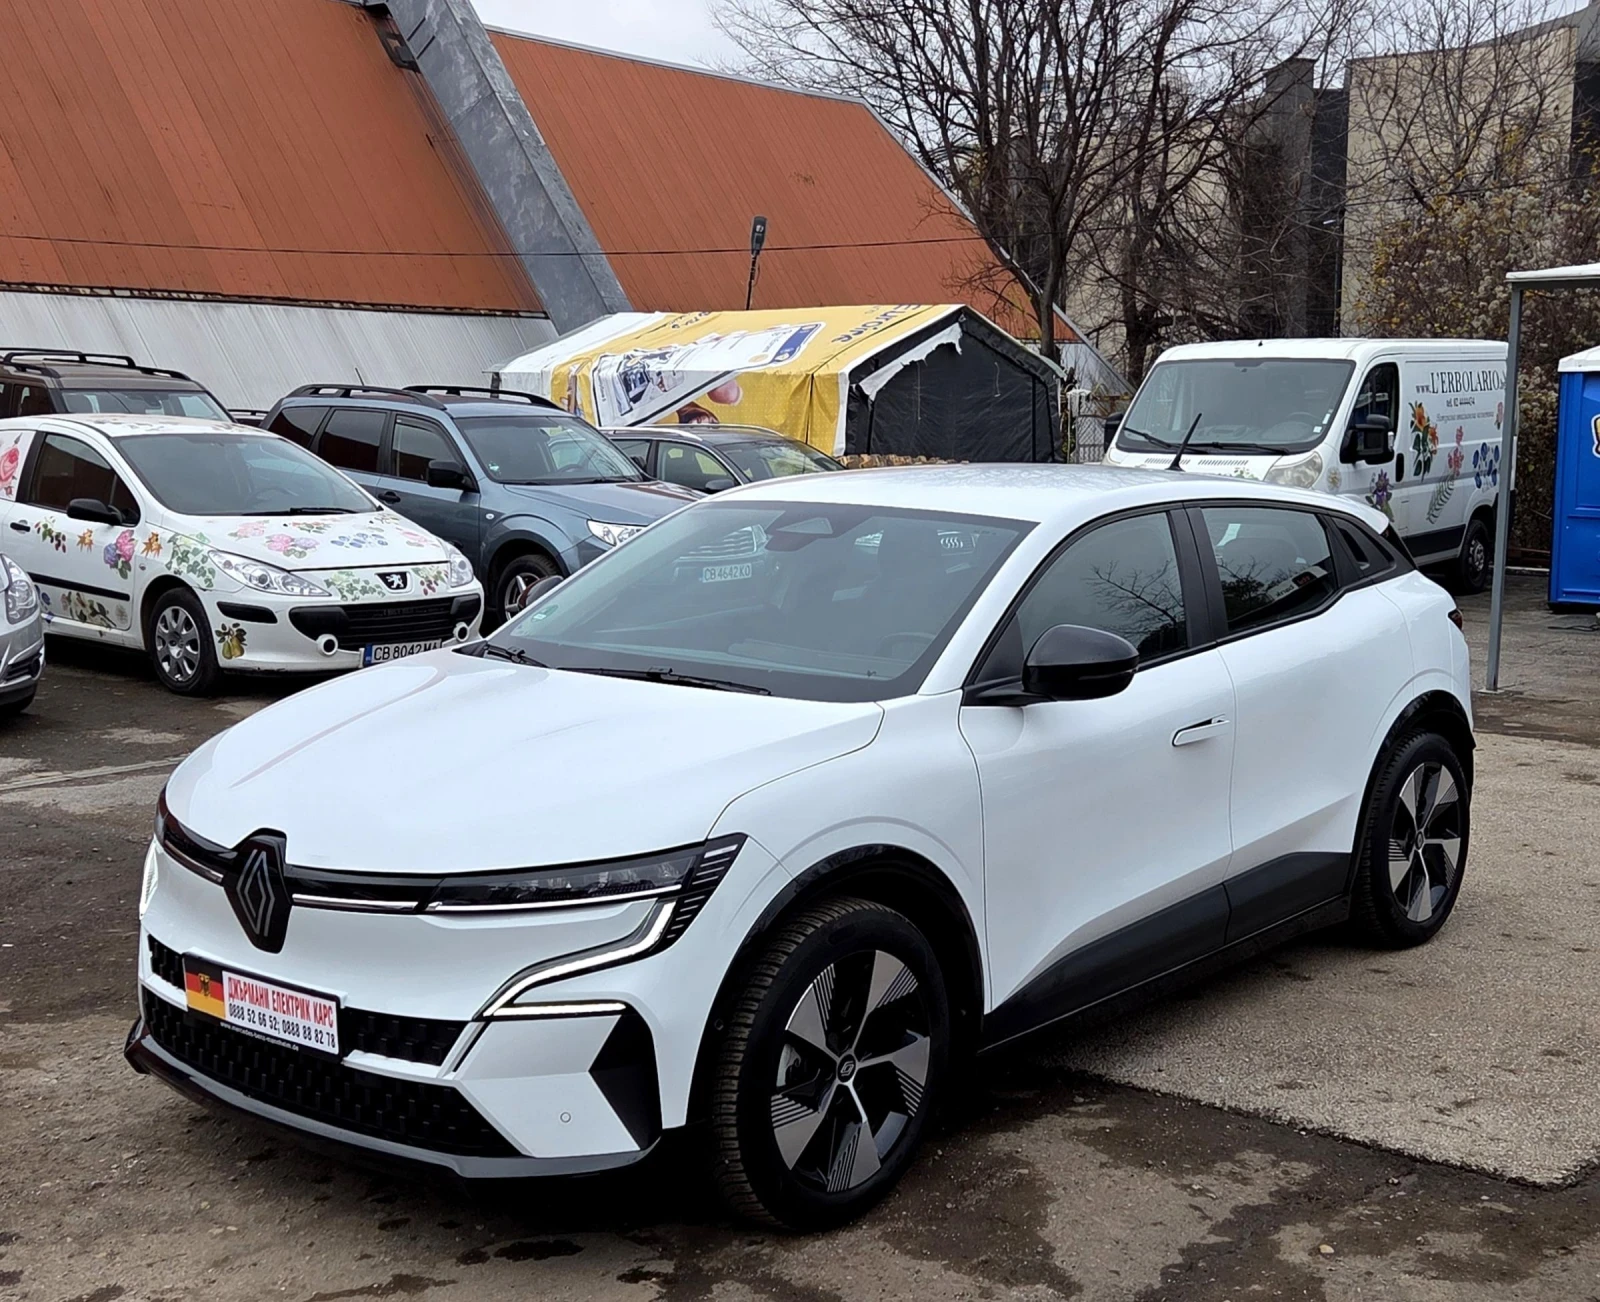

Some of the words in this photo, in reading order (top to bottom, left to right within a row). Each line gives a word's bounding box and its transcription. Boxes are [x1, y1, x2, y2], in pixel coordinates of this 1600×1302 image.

[374, 646, 391, 661] CB
[392, 644, 423, 659] 8042
[227, 976, 270, 1010] ДЖЪРМАНИ
[272, 990, 311, 1022] ЕЛЕКТРИК
[312, 1001, 334, 1029] КАРС
[228, 1003, 245, 1021] 0888
[247, 1008, 257, 1024] 52
[282, 1019, 301, 1038] 0888
[302, 1025, 312, 1041] 88
[314, 1028, 325, 1045] 82
[326, 1031, 336, 1049] 78
